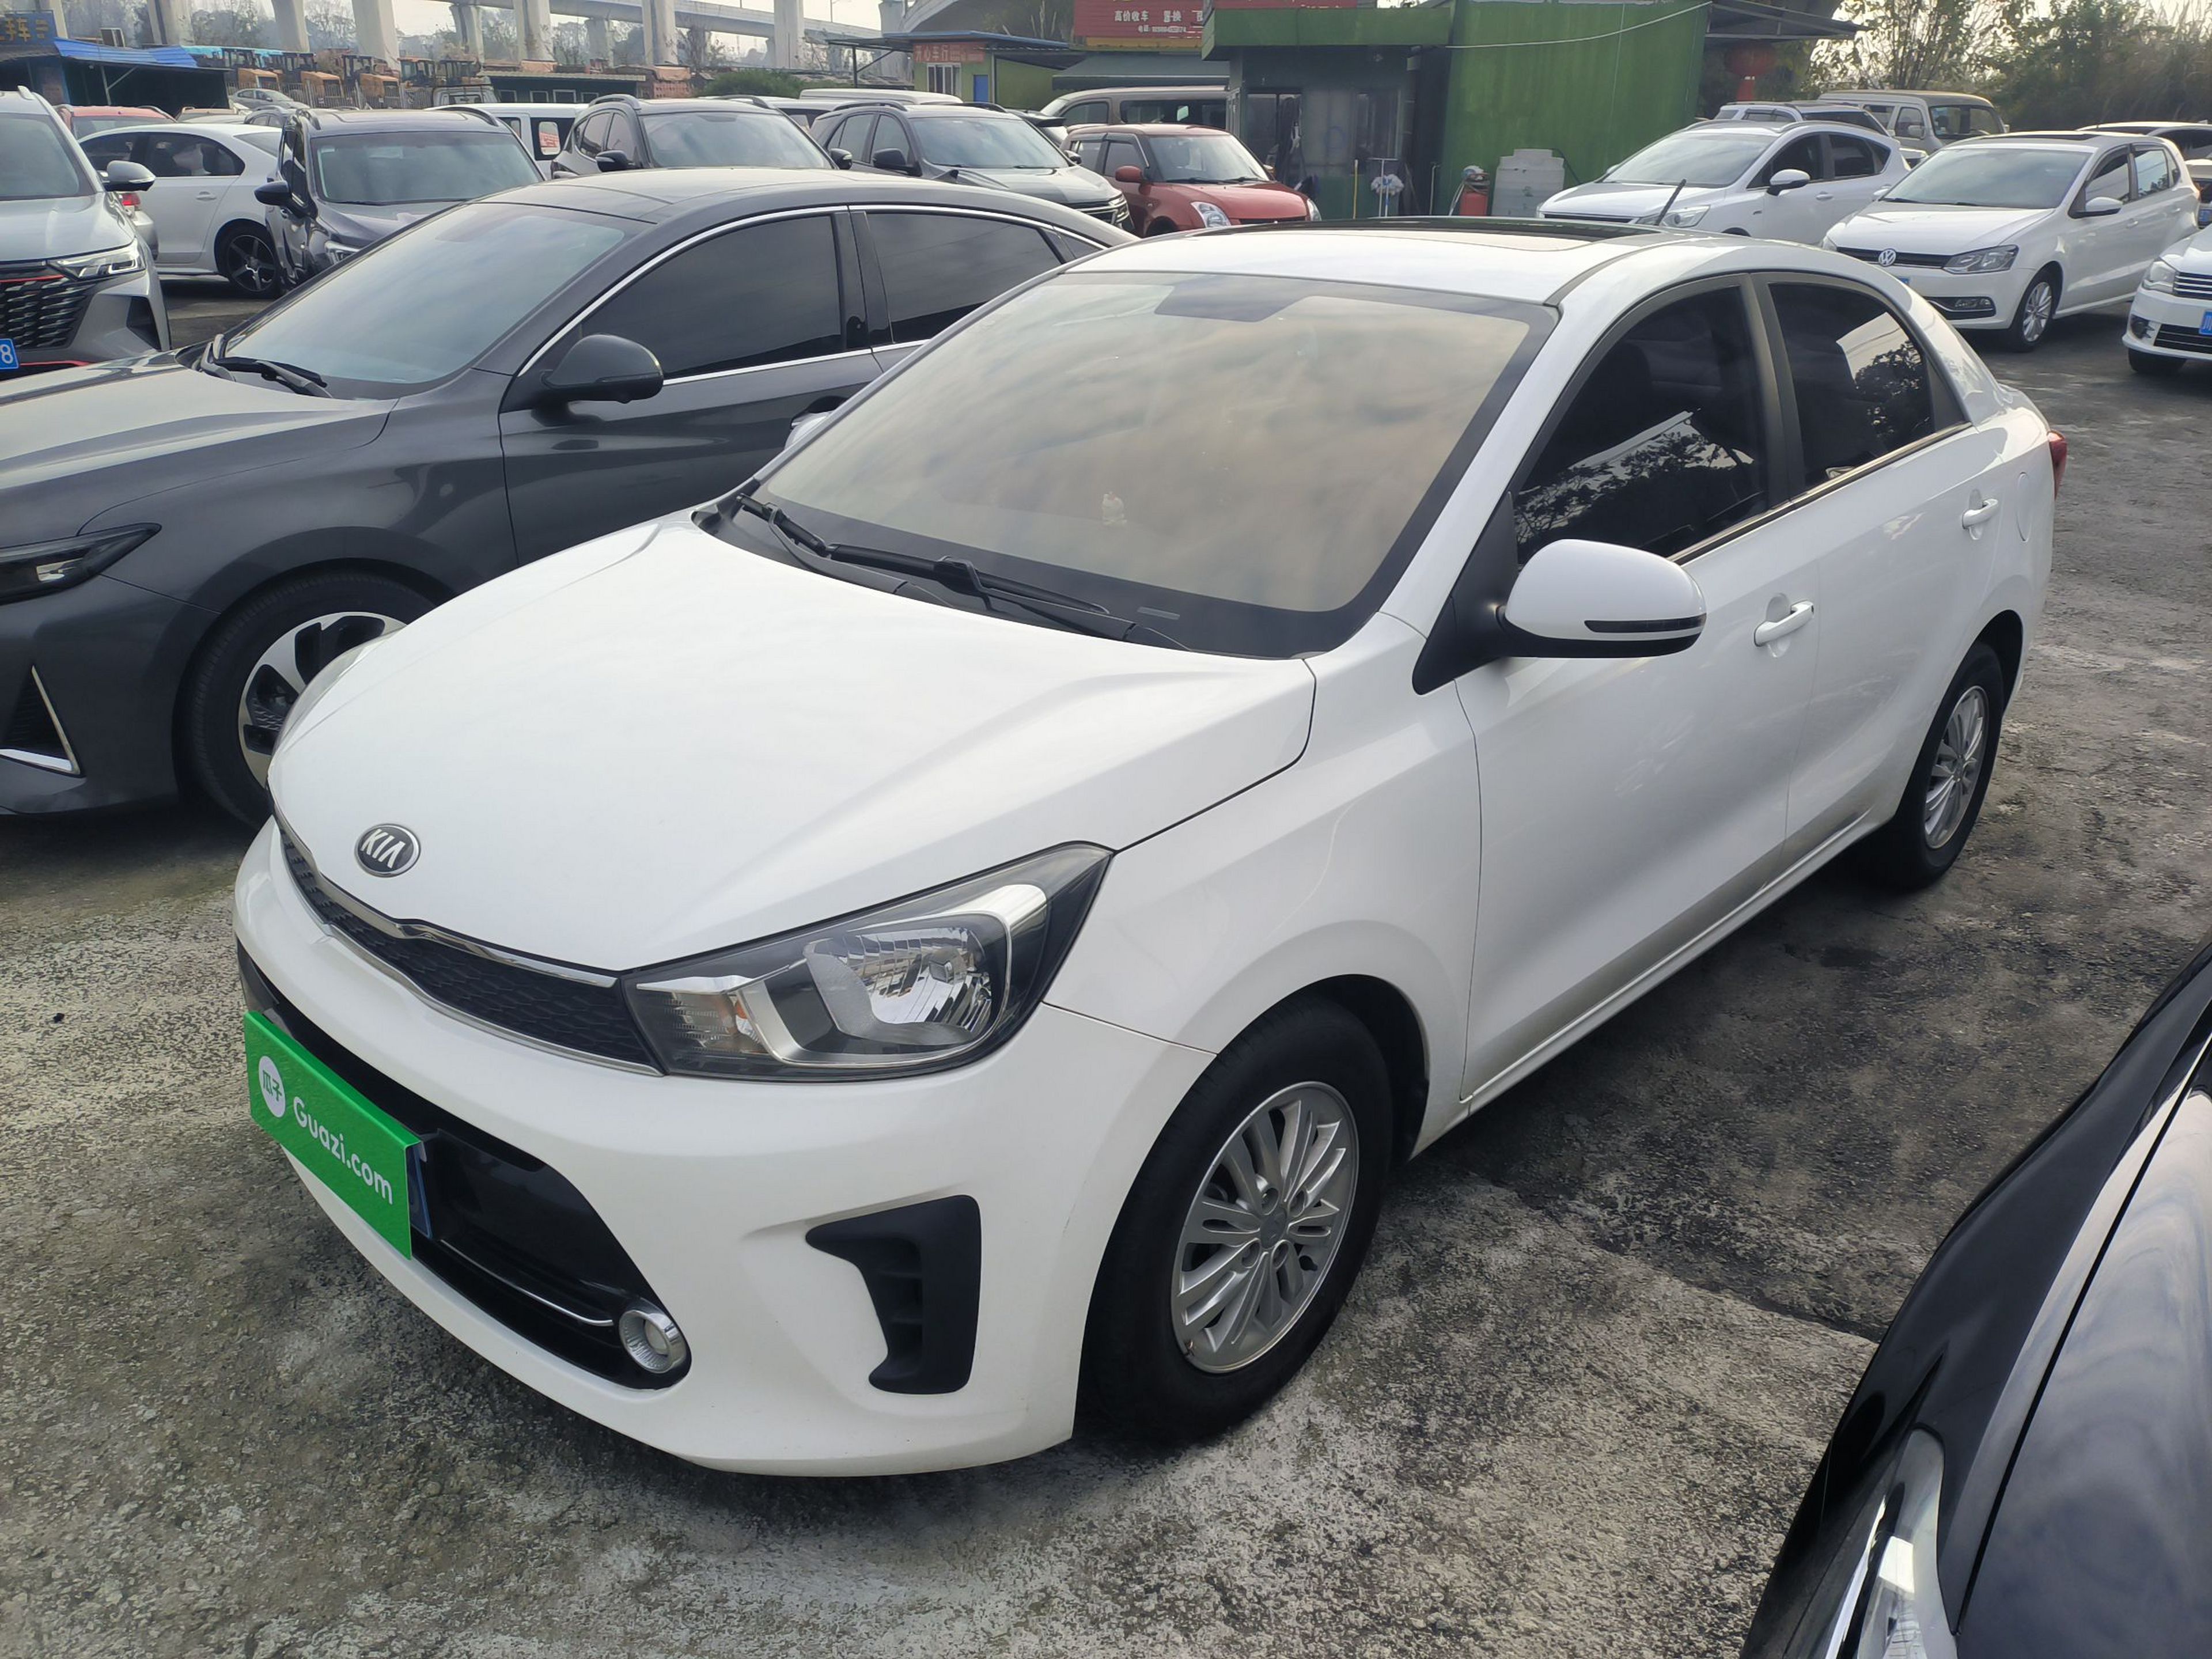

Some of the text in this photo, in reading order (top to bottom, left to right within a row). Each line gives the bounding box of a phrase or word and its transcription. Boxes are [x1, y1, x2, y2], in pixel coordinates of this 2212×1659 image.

[1115, 10, 1149, 22] 高价收车
[360, 828, 406, 869] KIA
[262, 1070, 282, 1101] 瓜子
[293, 1096, 393, 1205] Guazi.com
